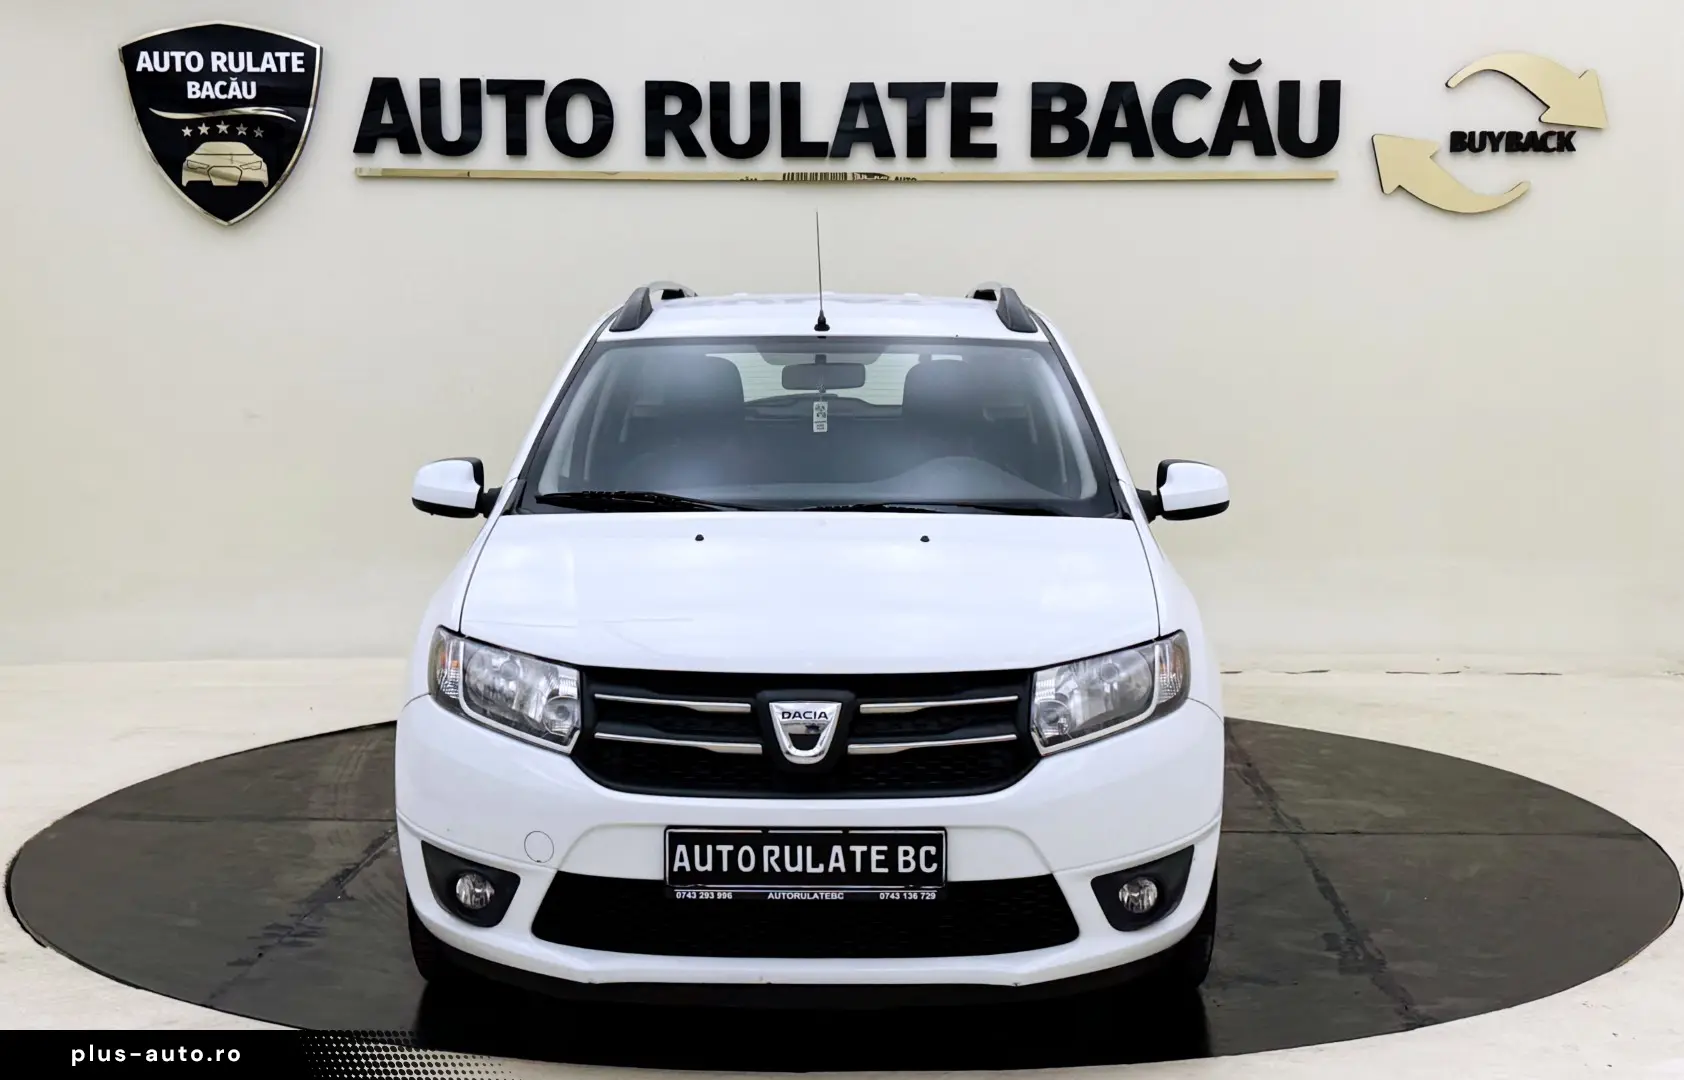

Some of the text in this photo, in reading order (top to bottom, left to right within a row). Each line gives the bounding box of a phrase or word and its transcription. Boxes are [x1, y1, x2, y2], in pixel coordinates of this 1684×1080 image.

[136, 51, 305, 72] AUTO RULATE
[186, 77, 257, 99] BACĂU
[353, 58, 1342, 159] AUTO RULATE BACĂU
[1449, 130, 1577, 153] BUYBACK
[781, 711, 829, 720] DACIA
[673, 844, 938, 873] AUTO RULATE BC
[676, 891, 697, 899] 0743
[699, 891, 715, 899] 293
[767, 892, 844, 900] AUTORULATEBC
[879, 892, 936, 900] 0743 136 729
